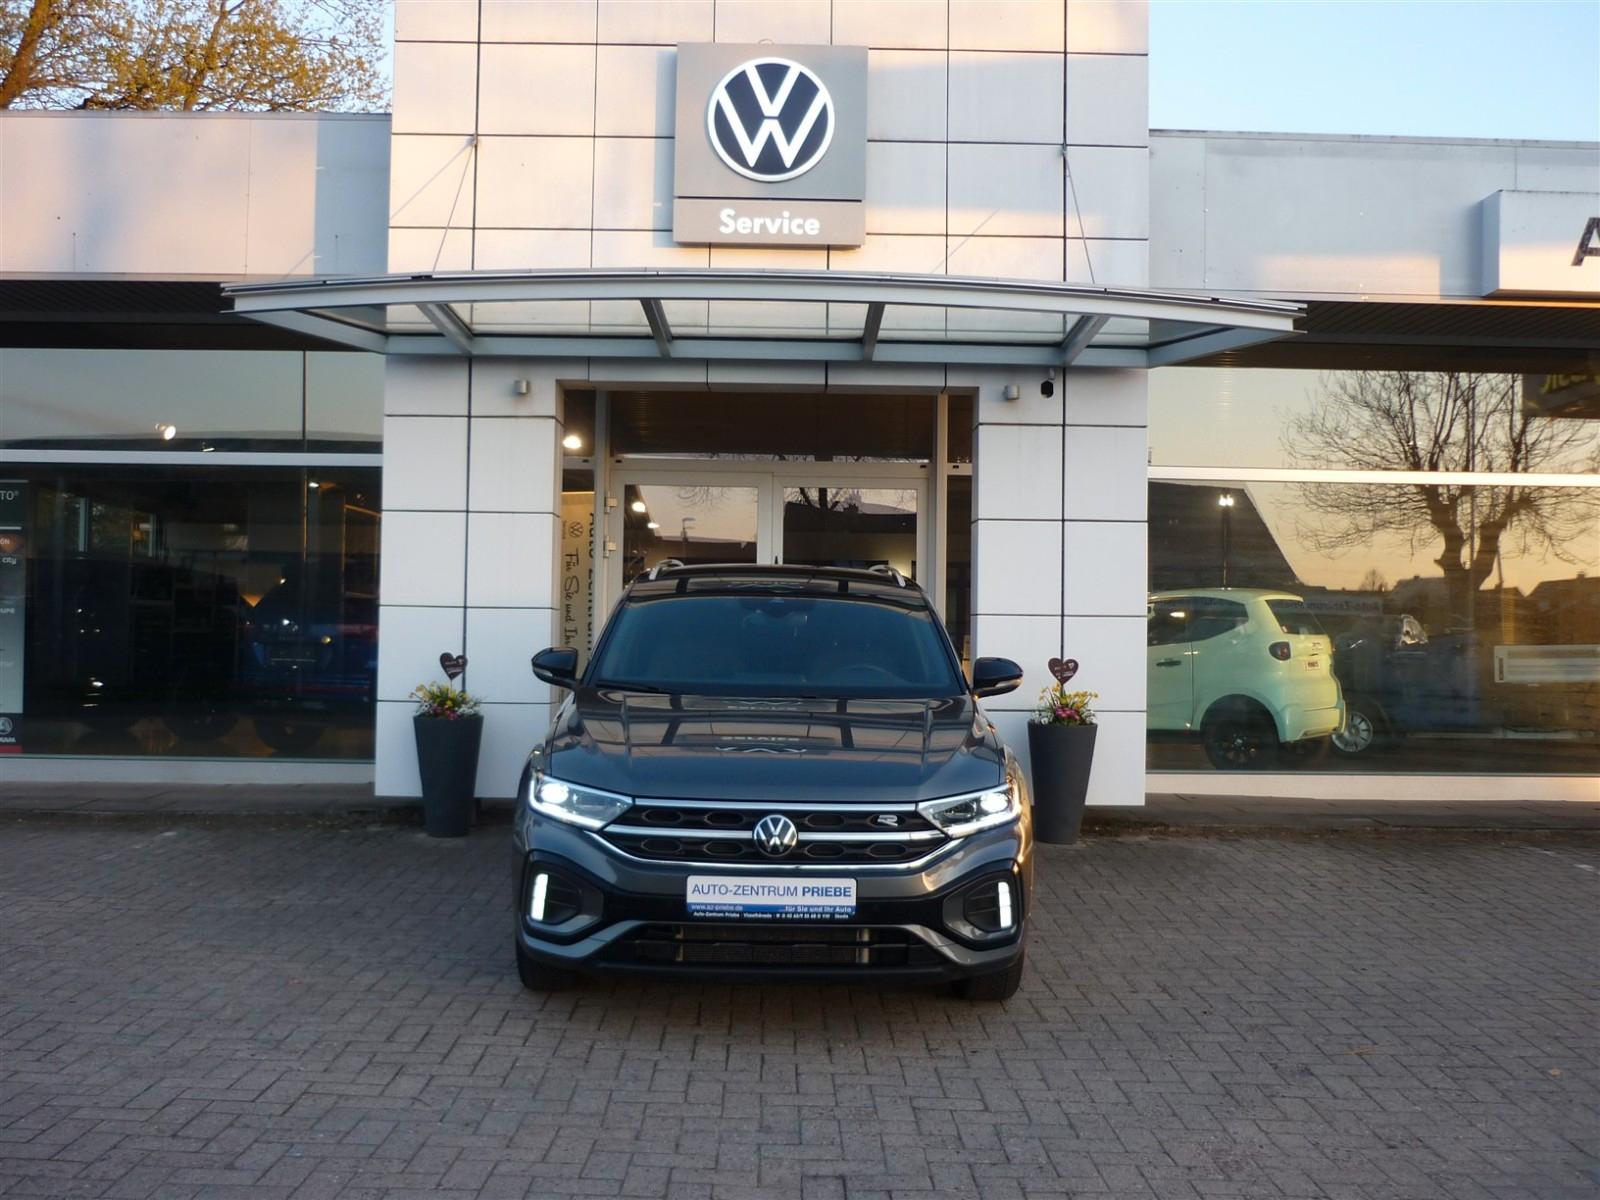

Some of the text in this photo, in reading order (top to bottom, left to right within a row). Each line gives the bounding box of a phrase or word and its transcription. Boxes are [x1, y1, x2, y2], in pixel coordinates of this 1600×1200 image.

[719, 208, 820, 235] Service
[564, 547, 579, 572] Für
[564, 575, 580, 601] Sie
[564, 603, 576, 623] und
[692, 884, 852, 898] AUTO-ZENTRUM PRIEBE
[810, 905, 822, 913] und
[835, 905, 852, 913] Auto
